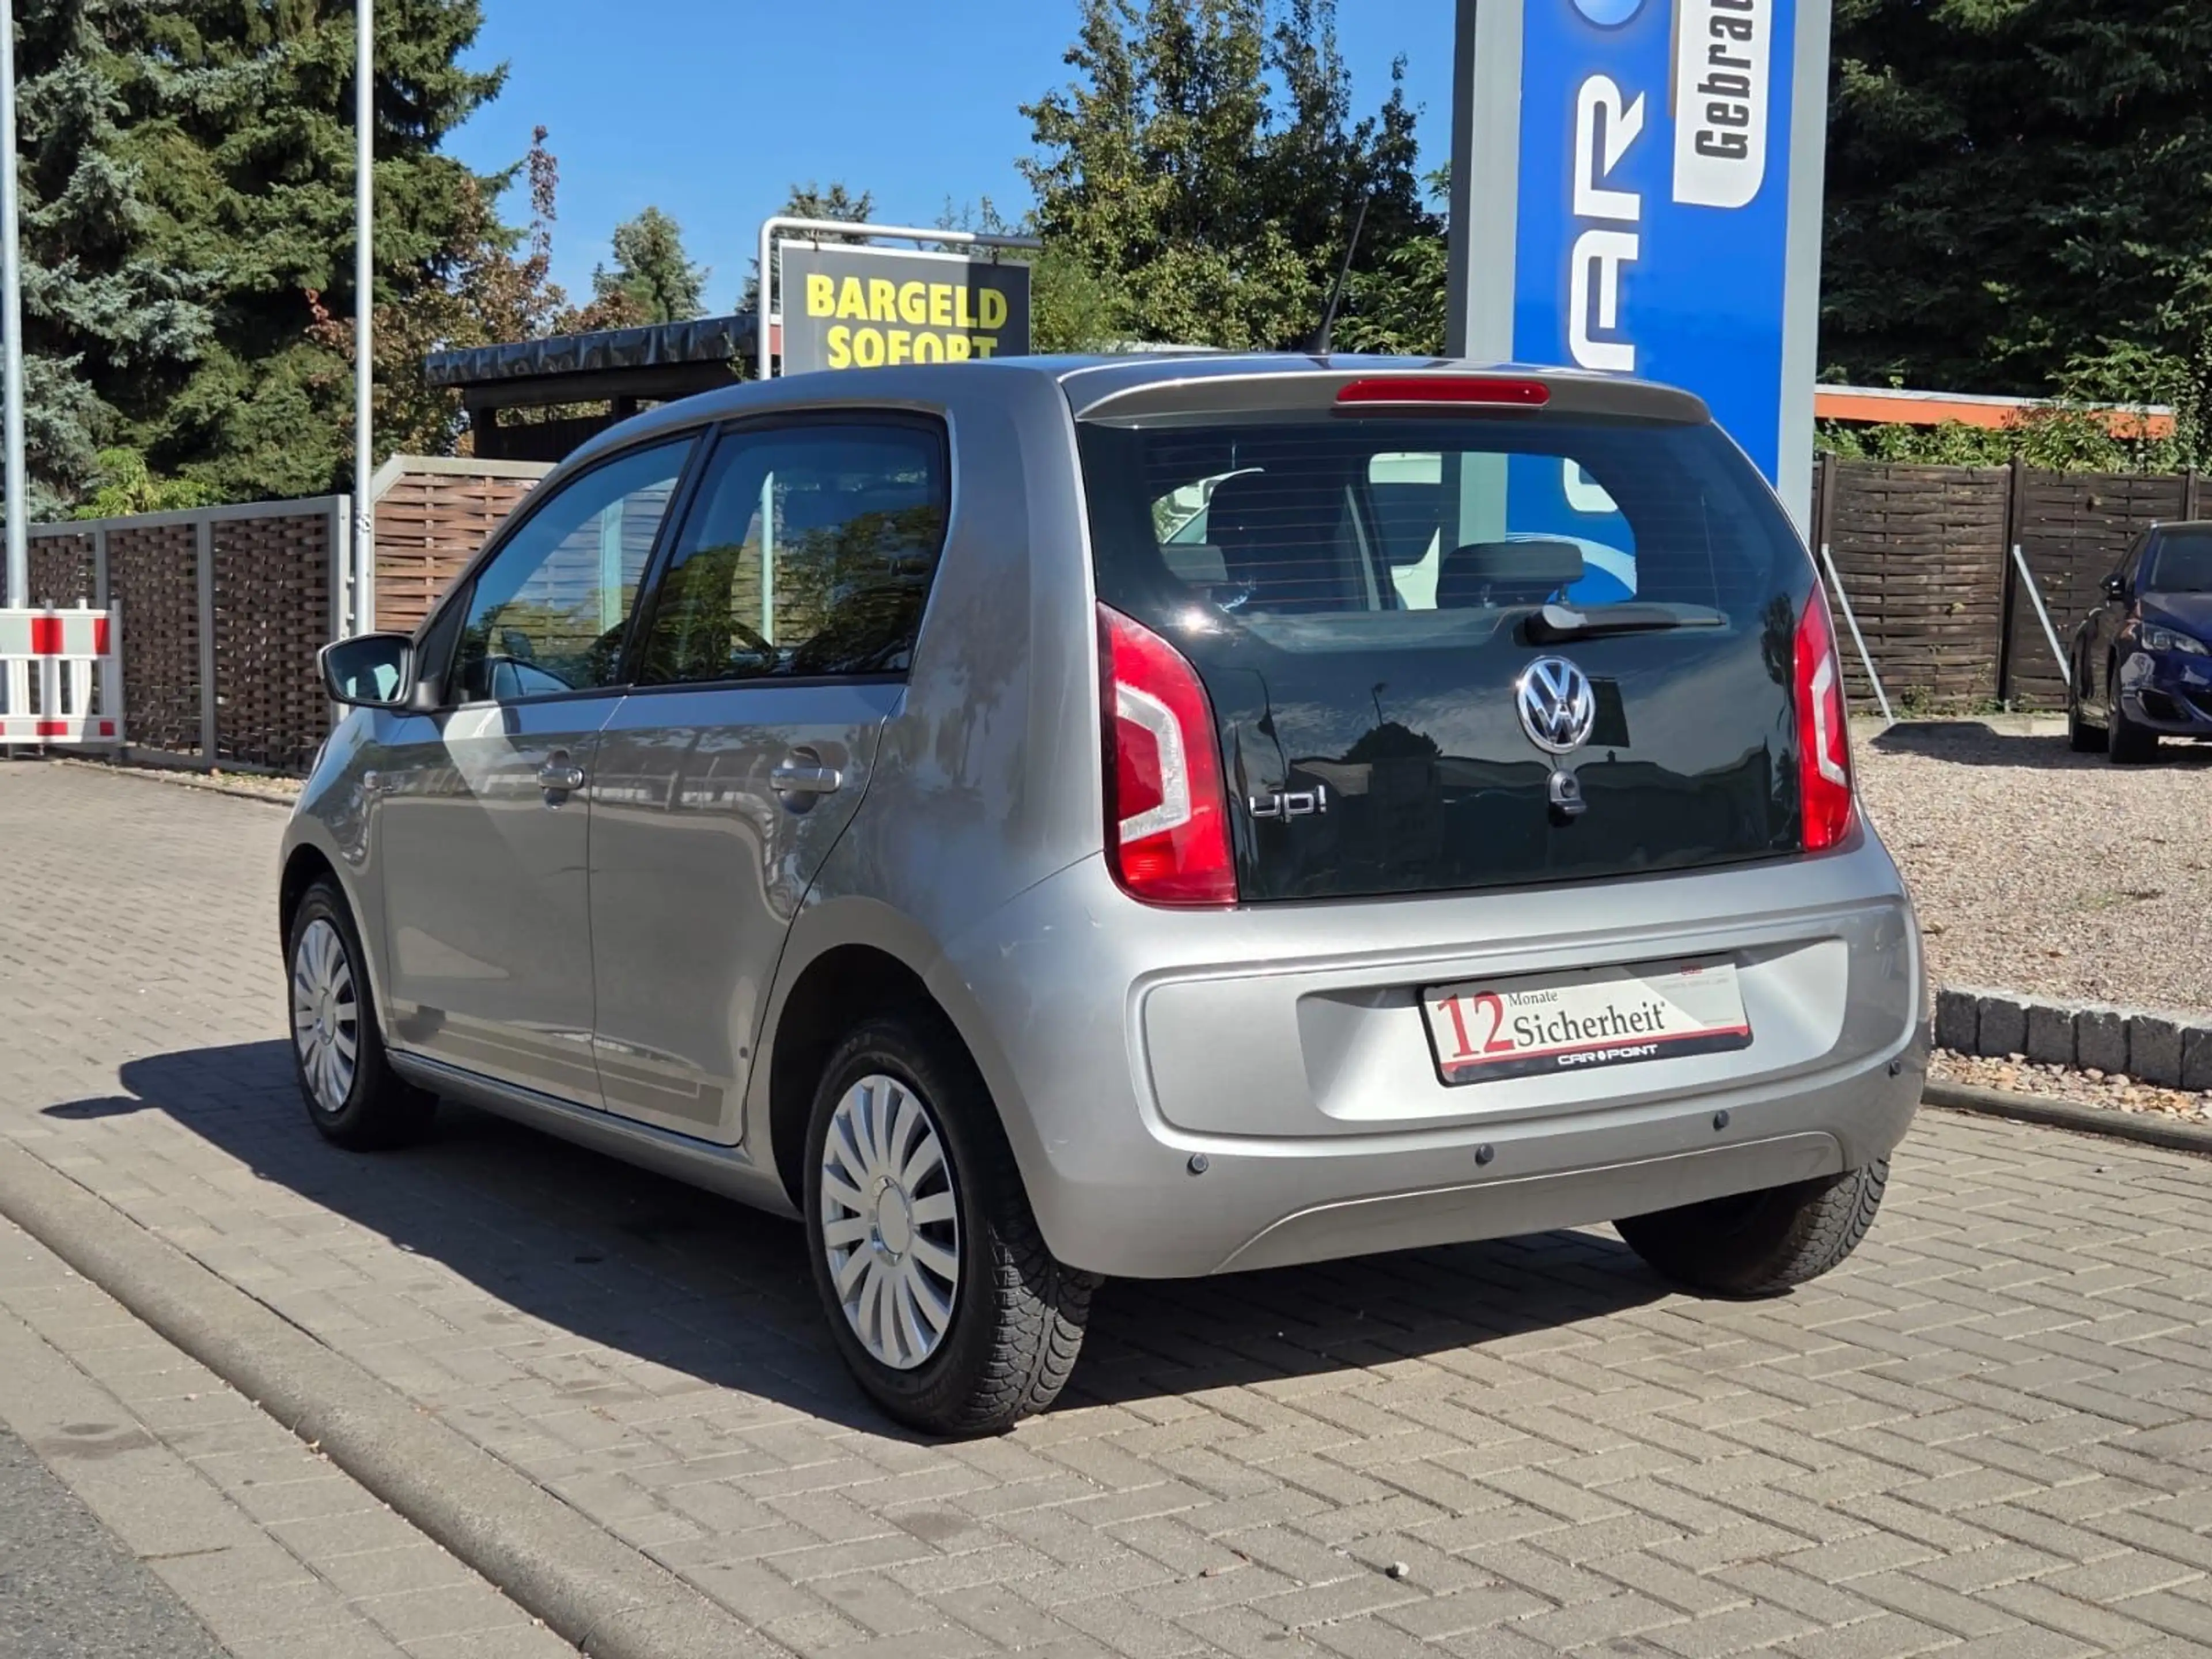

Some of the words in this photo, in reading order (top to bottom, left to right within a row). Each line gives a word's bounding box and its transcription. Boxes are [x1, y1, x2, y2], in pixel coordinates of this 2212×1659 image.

[807, 274, 1008, 329] BARGELD
[827, 325, 998, 369] SOFORT
[1520, 657, 1593, 751] VW
[1249, 785, 1327, 824] up!
[1508, 991, 1558, 1007] Monate
[1437, 990, 1516, 1058] 12
[1558, 1052, 1596, 1065] CAR
[1607, 1044, 1658, 1059] POINT
